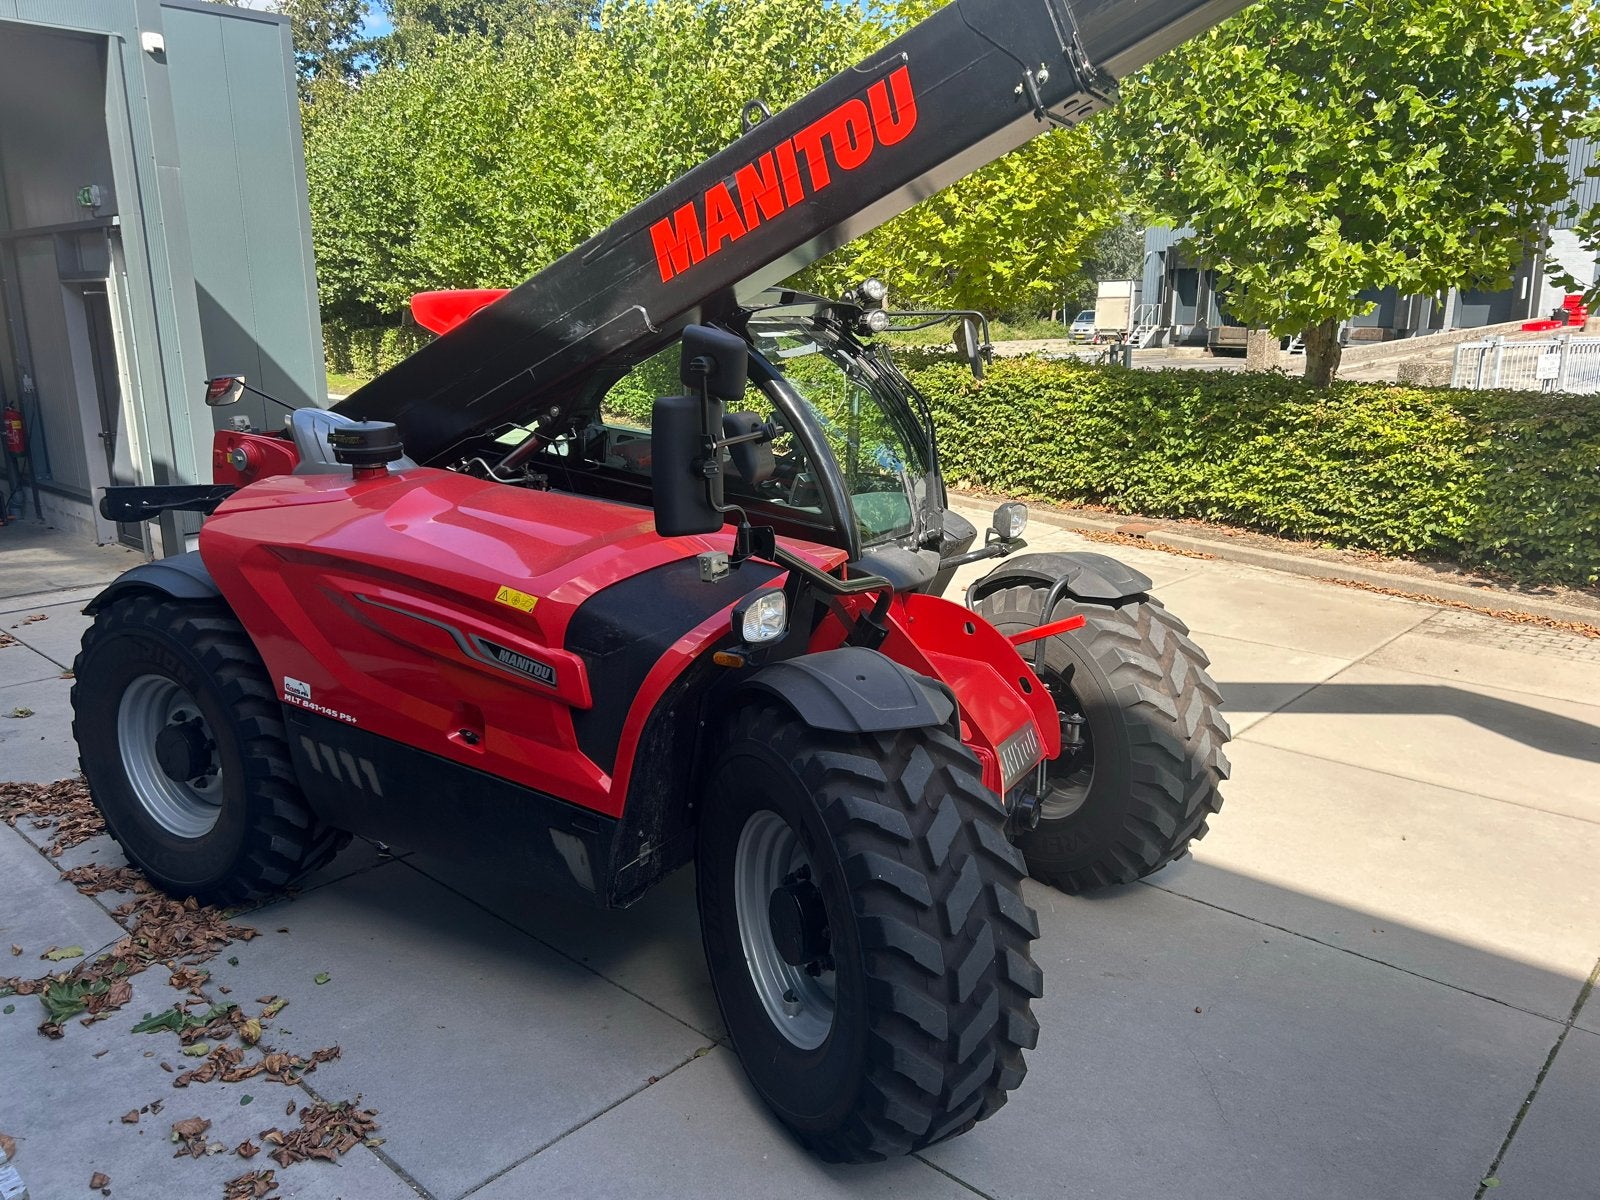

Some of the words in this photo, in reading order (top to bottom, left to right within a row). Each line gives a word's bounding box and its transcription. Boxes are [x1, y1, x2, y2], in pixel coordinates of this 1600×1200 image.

[650, 65, 918, 283] MANITOU
[499, 649, 551, 679] MANITOU
[284, 693, 301, 704] MLT
[302, 700, 338, 718] 841-145
[339, 712, 357, 723] PS+
